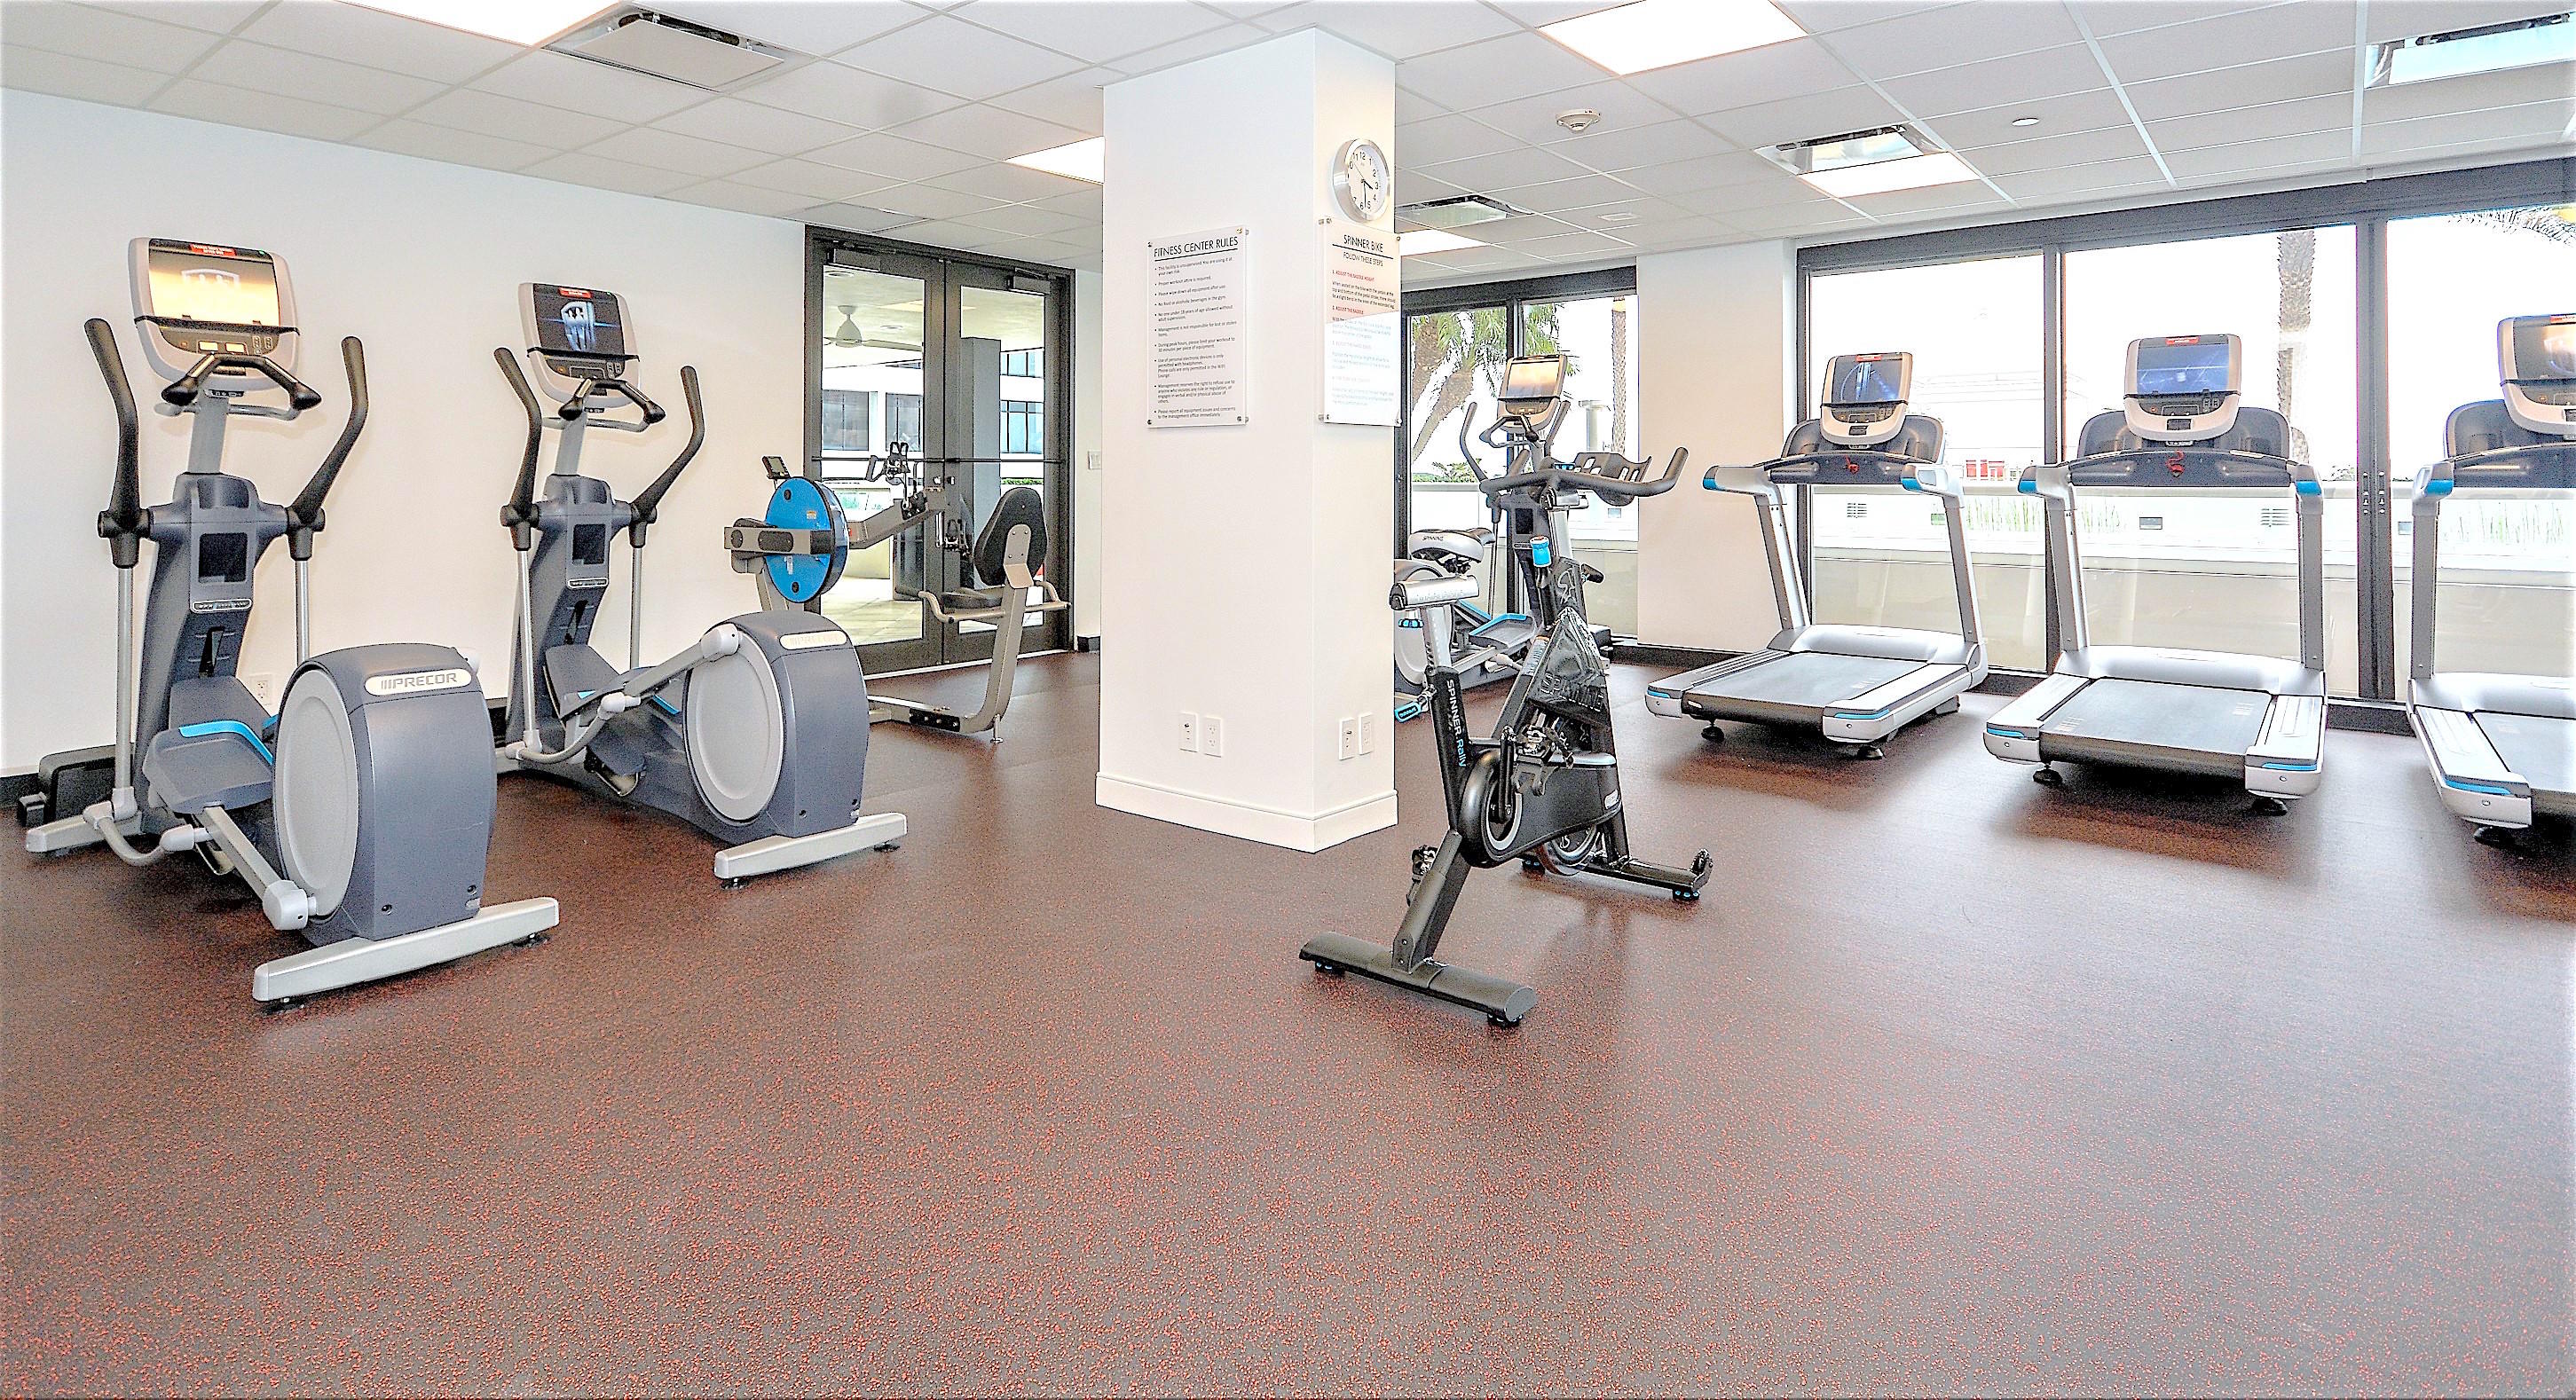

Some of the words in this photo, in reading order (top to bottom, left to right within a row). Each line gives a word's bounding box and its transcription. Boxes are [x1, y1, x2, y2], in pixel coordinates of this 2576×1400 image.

[1352, 152, 1359, 161] 11
[1360, 151, 1366, 161] 12
[1350, 161, 1353, 169] 0
[1372, 169, 1376, 177] 2
[1154, 245, 1181, 257] FITNESS
[1184, 240, 1214, 253] CENTER
[1217, 236, 1238, 248] RULES
[1343, 234, 1370, 249] SPINNER
[1371, 240, 1383, 252] BIKE
[1343, 252, 1360, 261] FOLLOW
[1361, 256, 1373, 264] THESE
[392, 672, 458, 688] PRECOR
[1446, 679, 1462, 735] SPINNER
[1456, 738, 1467, 767] Rally
